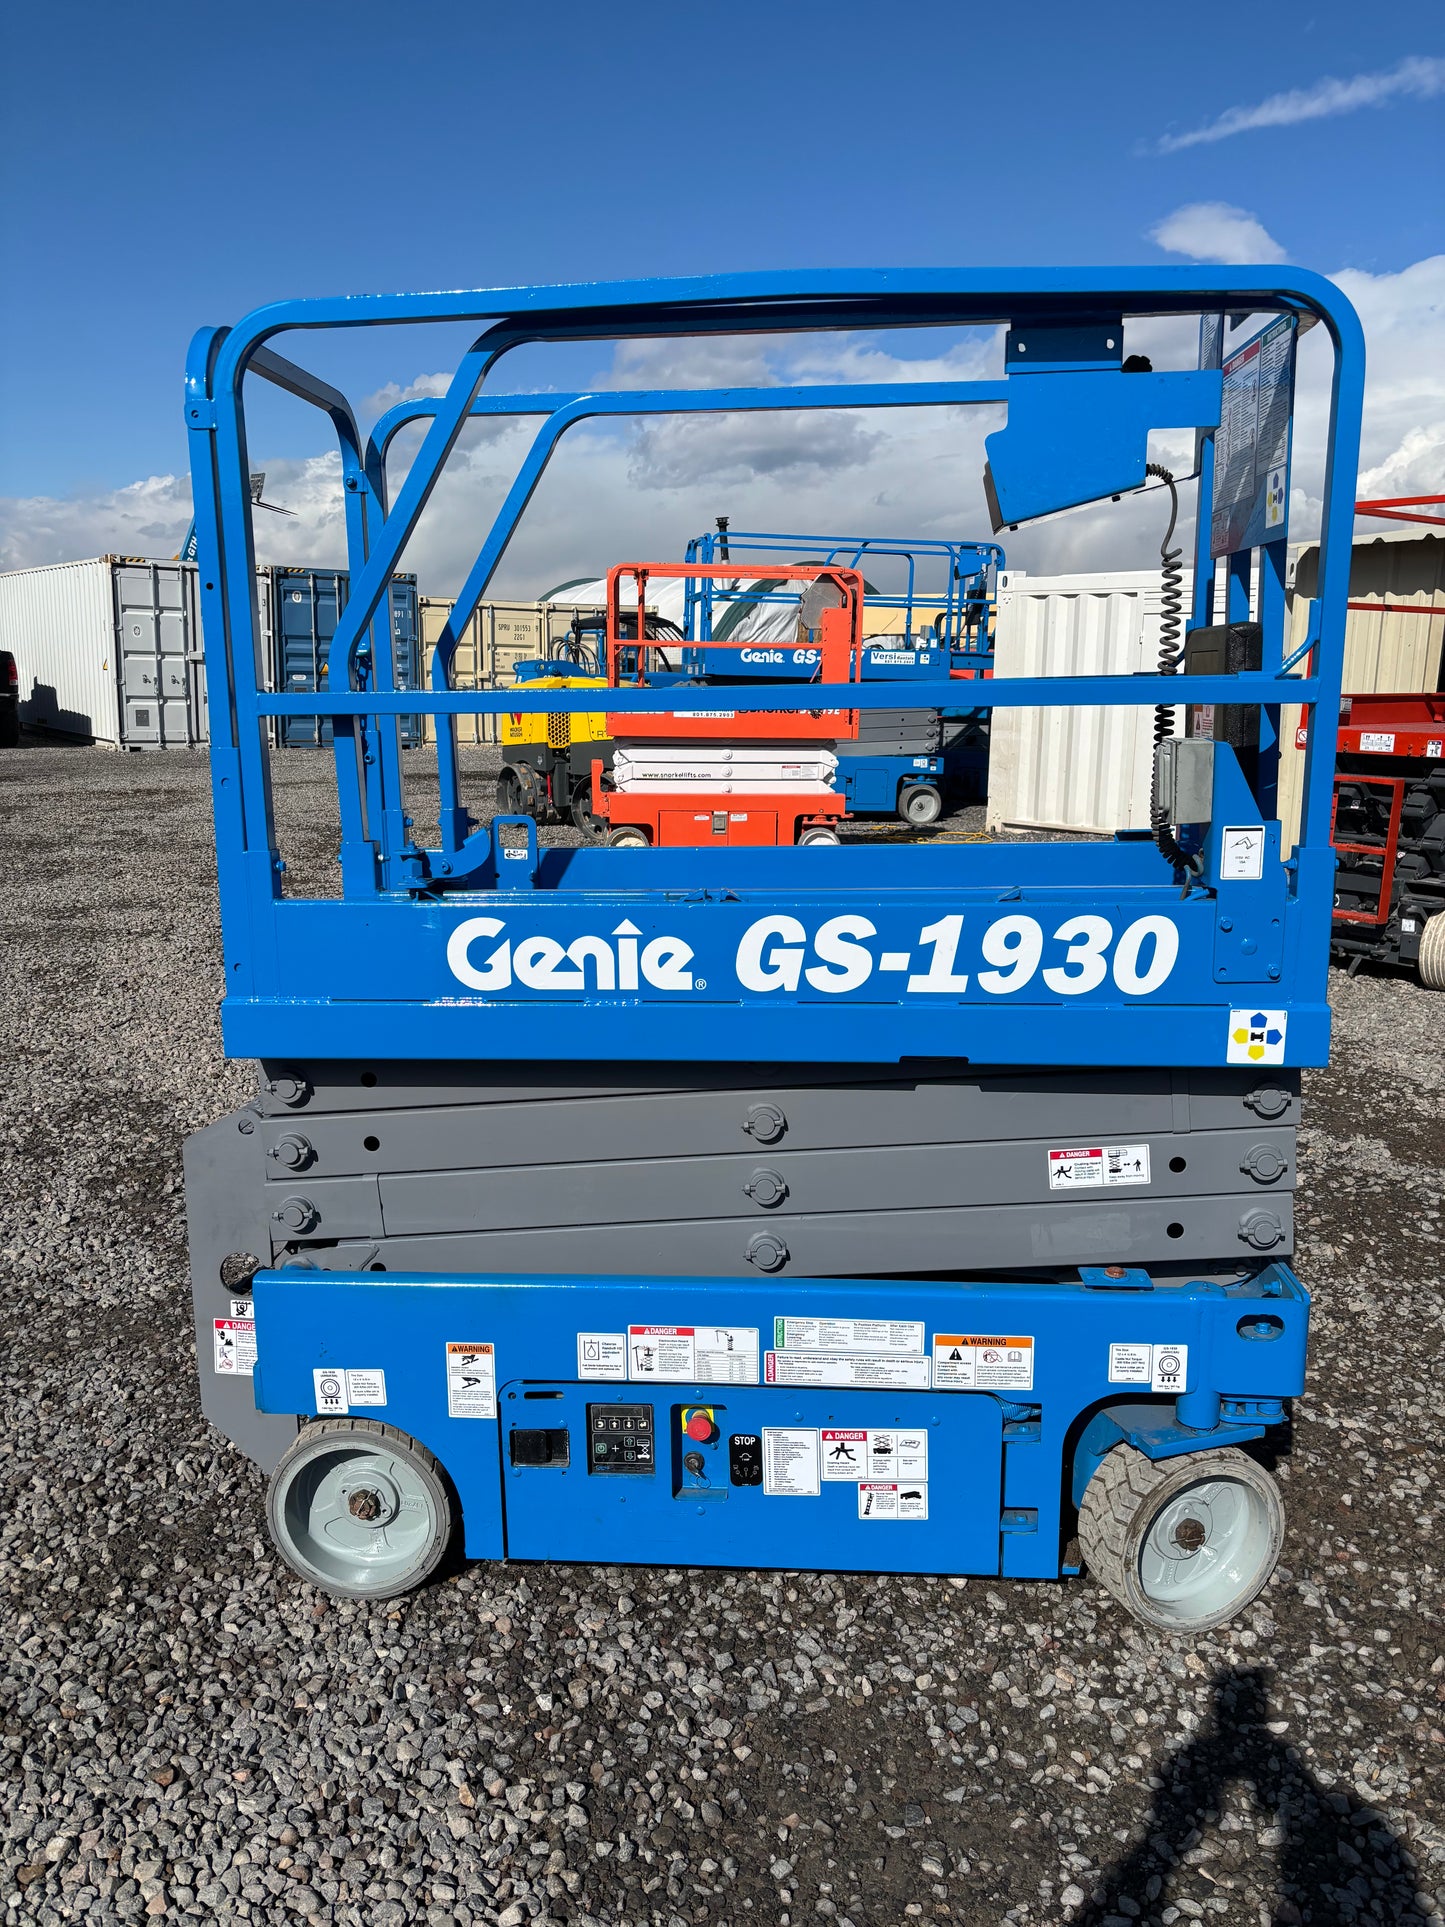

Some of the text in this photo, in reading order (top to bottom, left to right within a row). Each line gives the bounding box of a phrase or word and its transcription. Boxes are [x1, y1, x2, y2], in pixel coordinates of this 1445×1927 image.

[740, 648, 784, 663] Genie
[446, 914, 1180, 995] Genie GS-1930
[232, 1322, 256, 1330] DANGE
[970, 1337, 1006, 1346] WARNING
[734, 1436, 756, 1445] STOP
